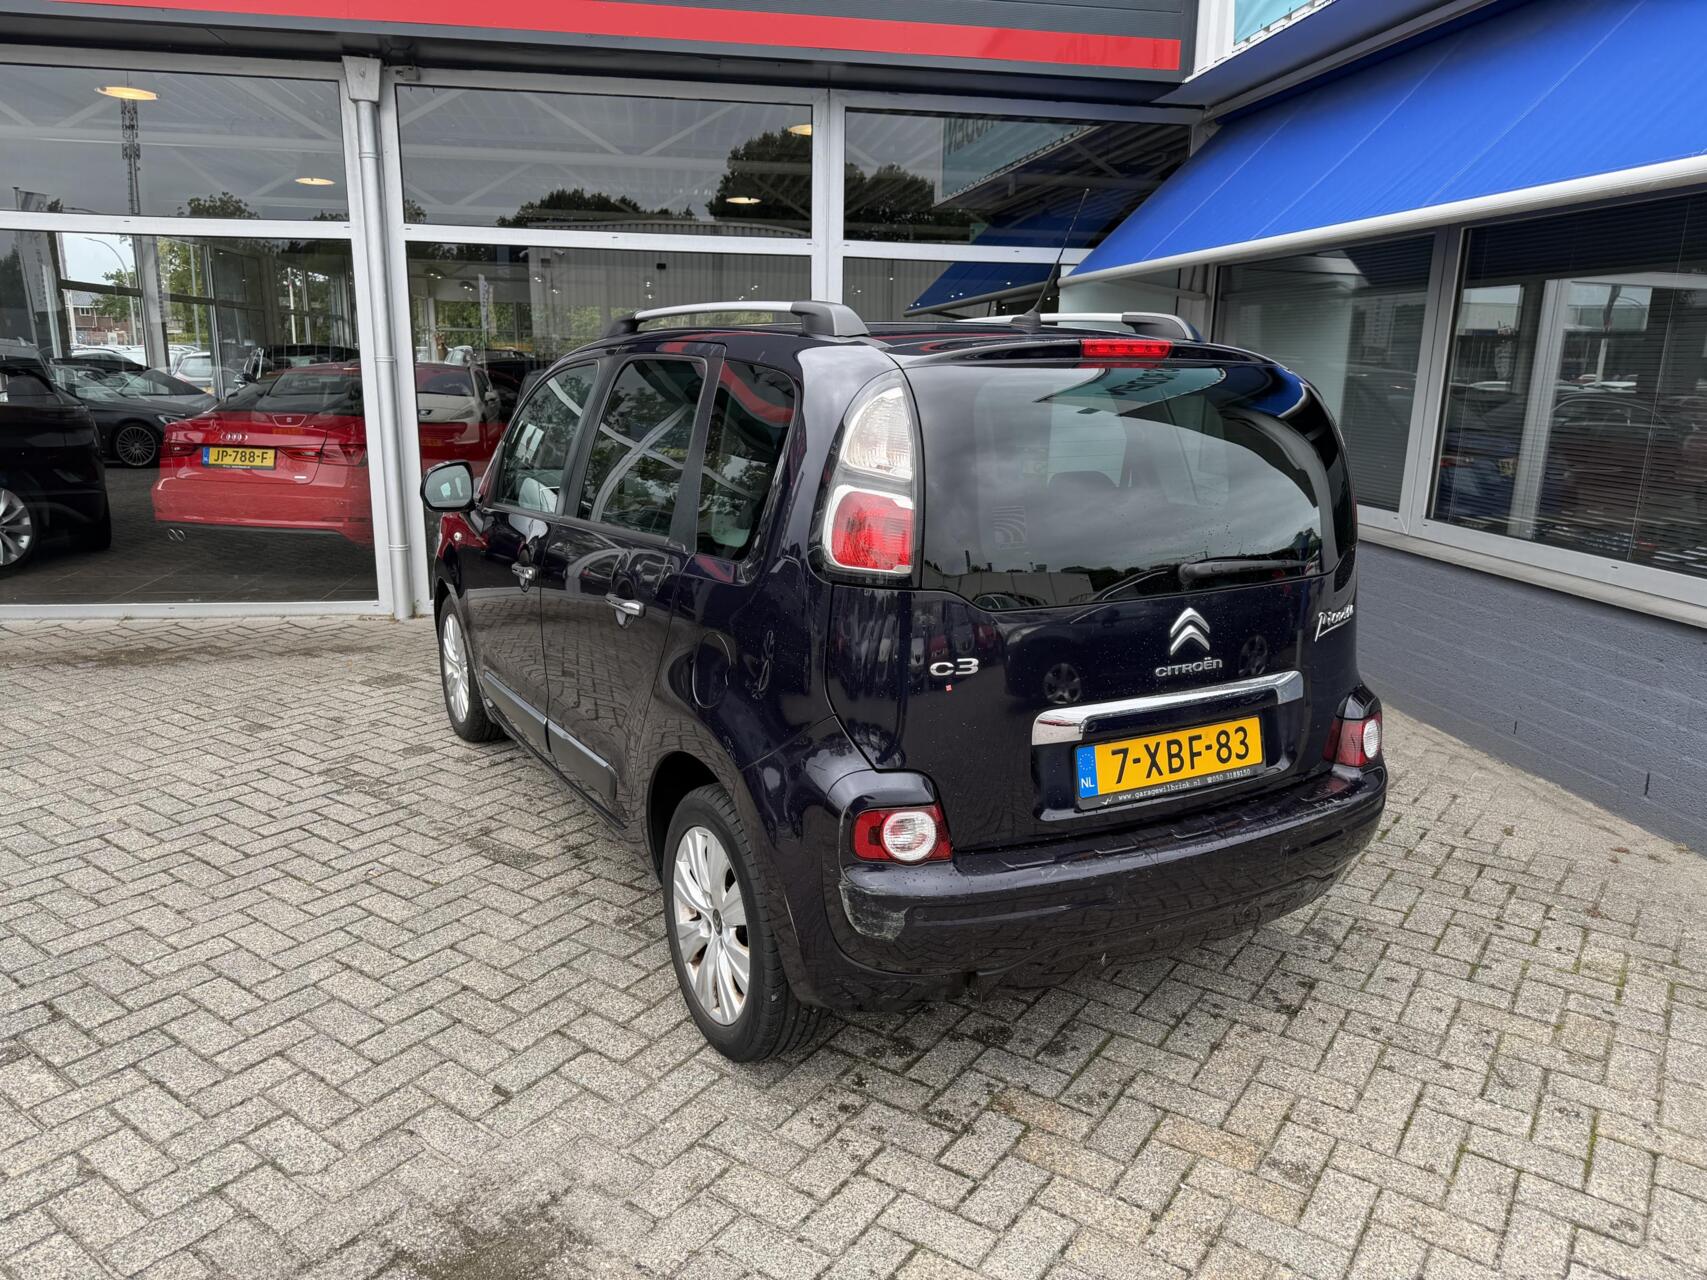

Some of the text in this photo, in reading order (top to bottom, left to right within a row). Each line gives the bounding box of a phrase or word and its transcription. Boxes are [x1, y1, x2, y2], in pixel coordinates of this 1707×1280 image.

[213, 449, 269, 464] JP-788-F
[929, 657, 979, 677] C3
[1111, 725, 1250, 785] 7-XBF-83
[1080, 777, 1095, 789] NL
[1118, 778, 1201, 800] www.garagewilbrink.nl
